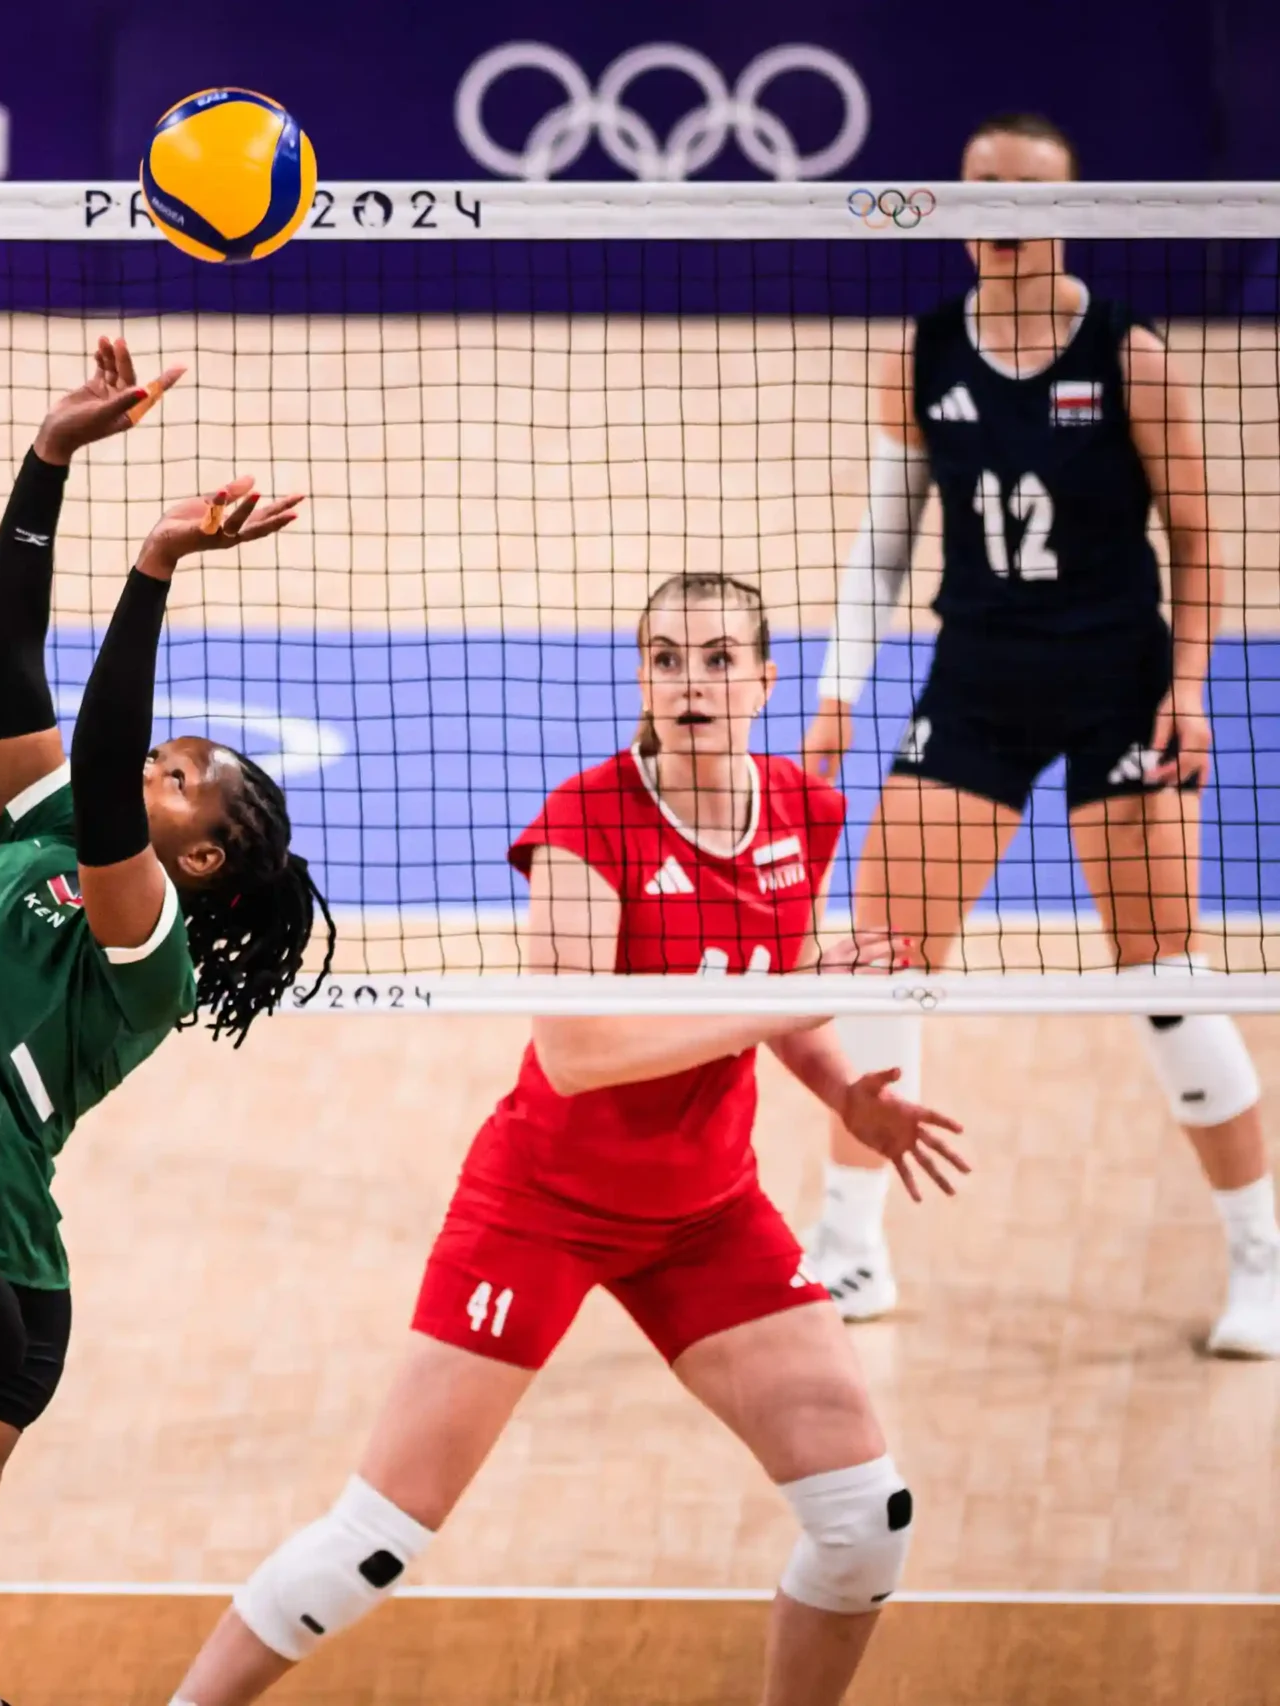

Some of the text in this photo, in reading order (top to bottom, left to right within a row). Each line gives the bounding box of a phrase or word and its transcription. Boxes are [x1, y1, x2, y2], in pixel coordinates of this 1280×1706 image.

[312, 190, 480, 229] 2024
[972, 467, 1058, 581] 12
[23, 892, 66, 929] KEN
[327, 985, 431, 1008] 2024
[466, 1280, 514, 1337] 41
